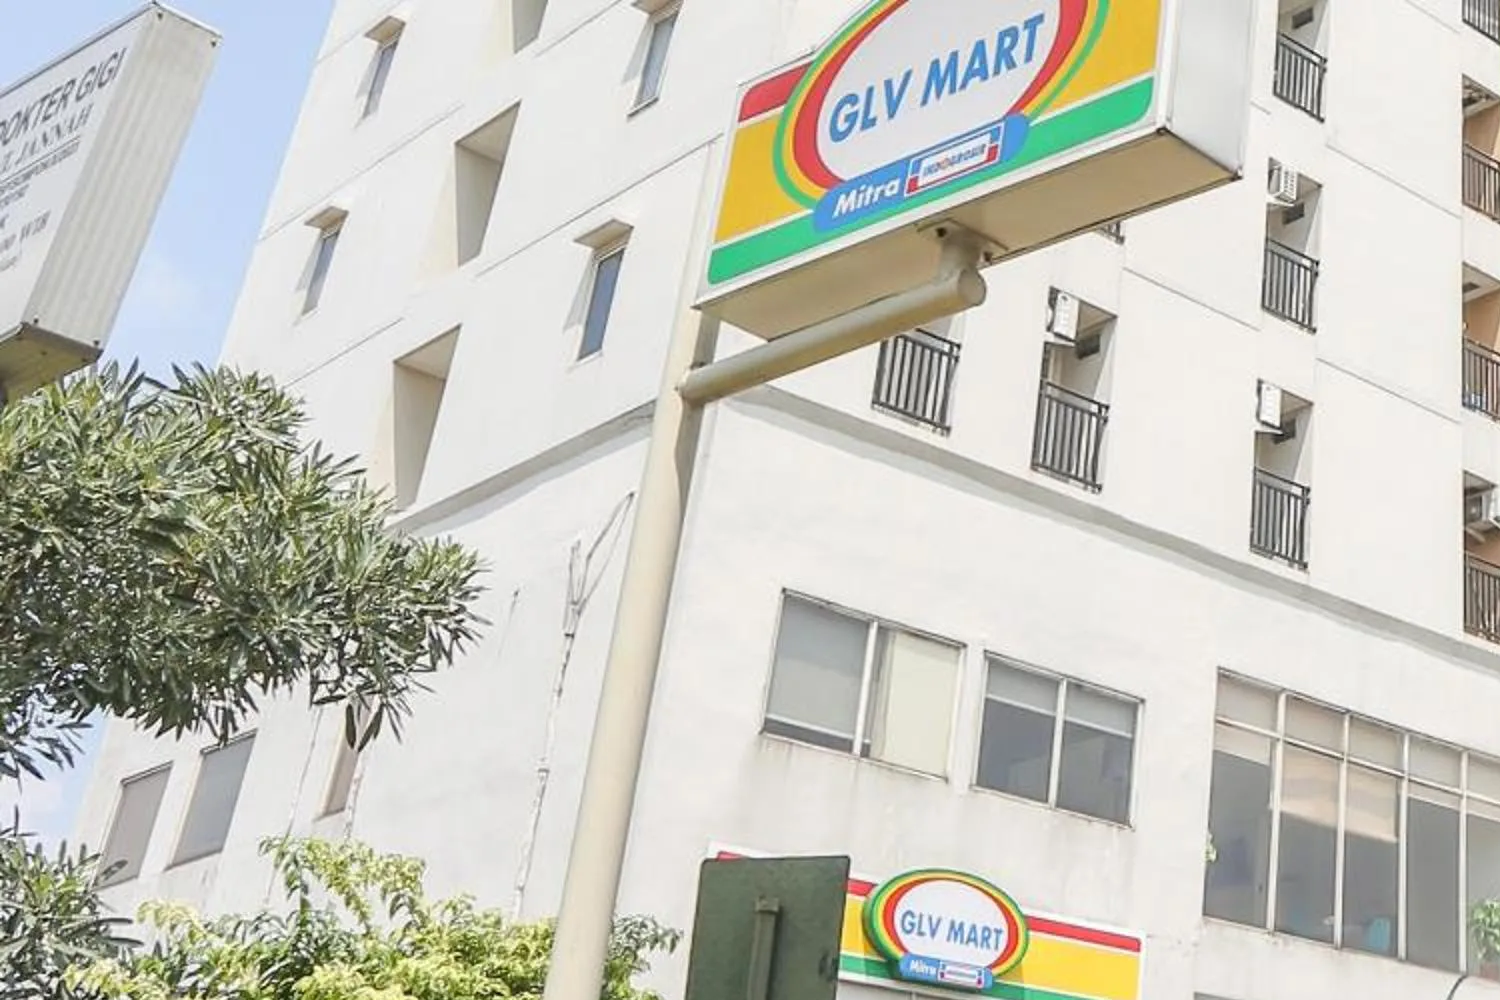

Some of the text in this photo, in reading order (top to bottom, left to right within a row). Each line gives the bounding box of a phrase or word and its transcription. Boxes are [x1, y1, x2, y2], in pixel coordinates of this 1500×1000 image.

[76, 47, 127, 102] GIGI
[829, 13, 1045, 143] GLV MART
[832, 177, 900, 219] Mitra
[901, 909, 1003, 951] GLV MART
